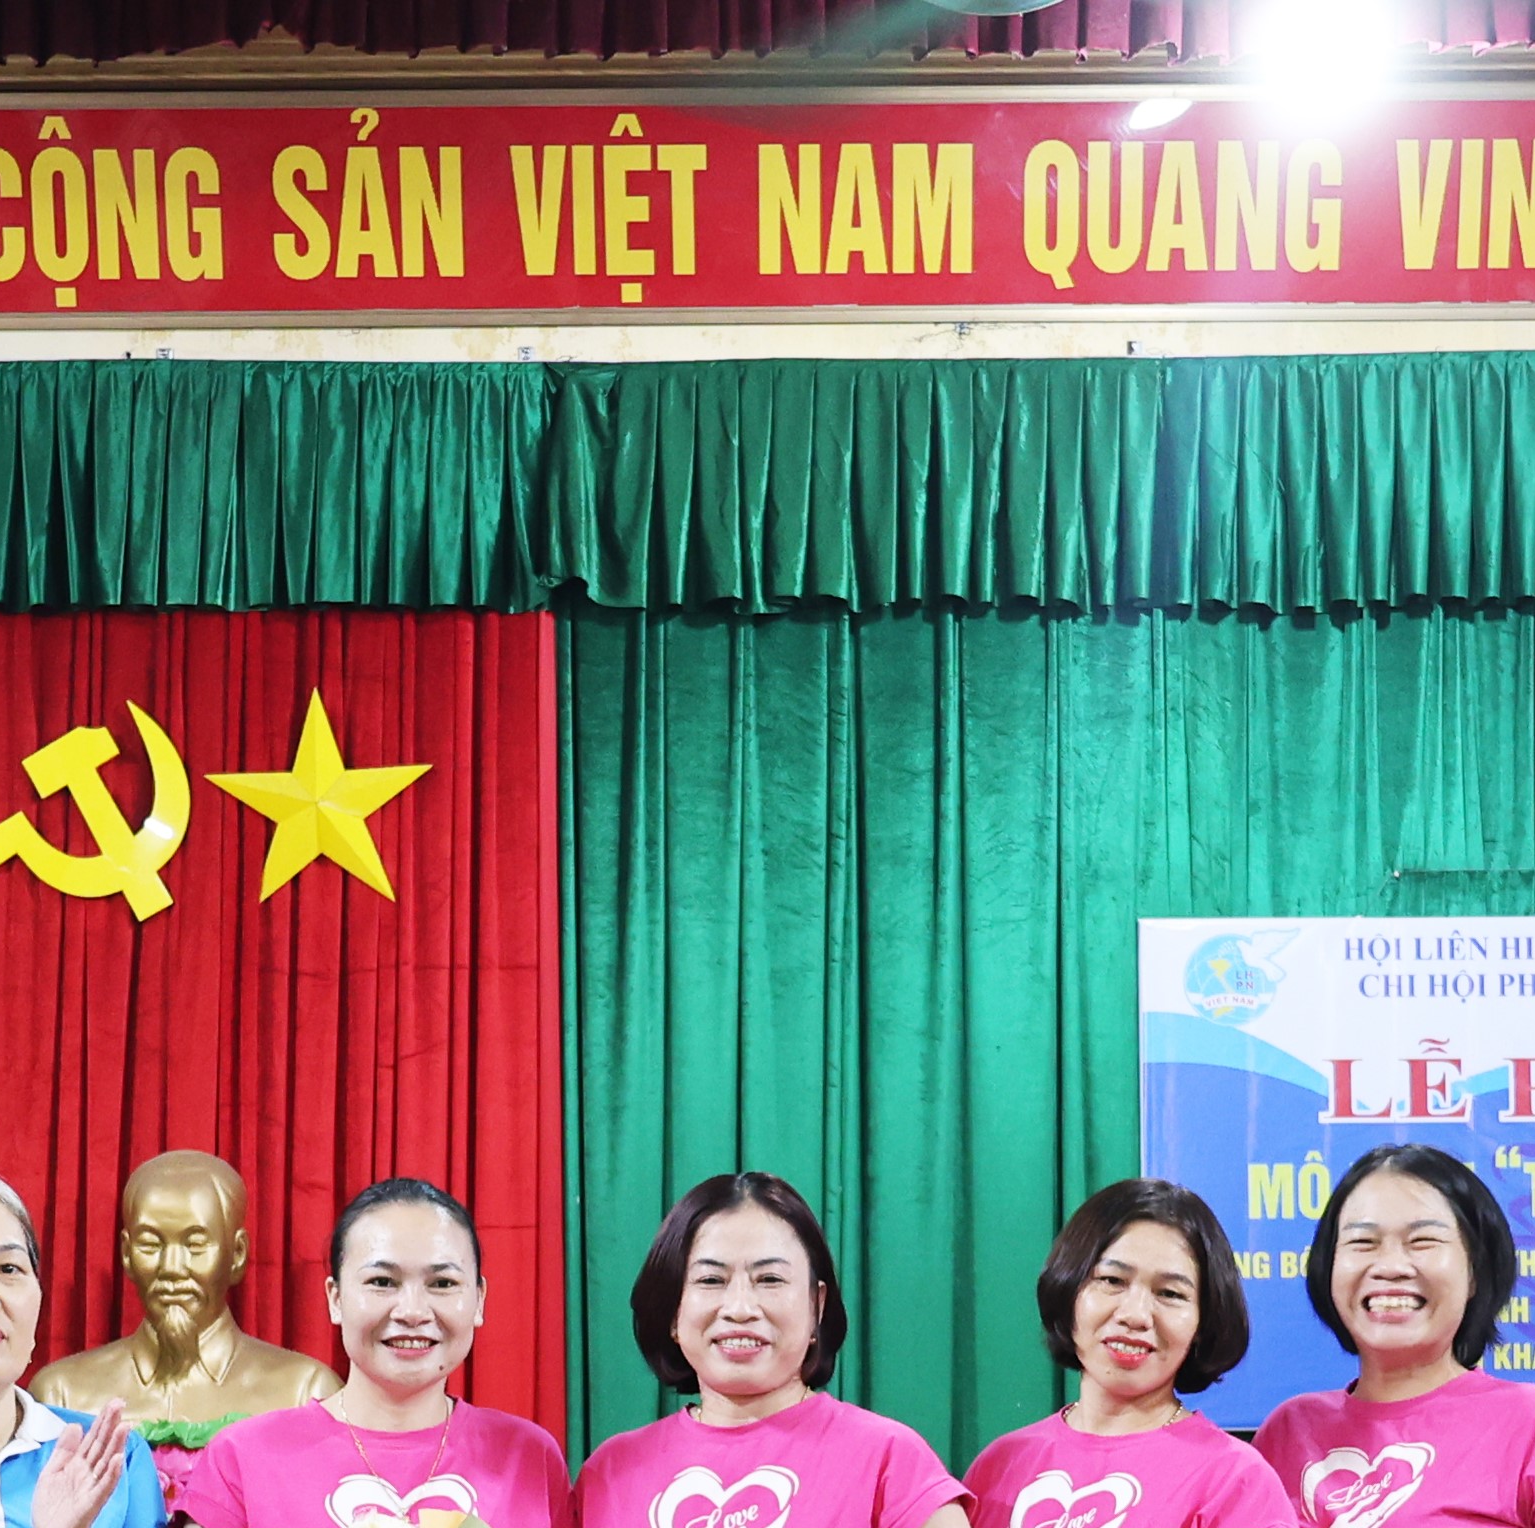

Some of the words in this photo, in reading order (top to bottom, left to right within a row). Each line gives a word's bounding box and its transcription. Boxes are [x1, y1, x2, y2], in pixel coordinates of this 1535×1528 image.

[272, 107, 467, 280] SẢN
[509, 114, 708, 303] VIỆT
[756, 140, 975, 276] NAM
[1021, 137, 1344, 292] QUANG
[1343, 932, 1402, 968] HỘI
[1413, 929, 1490, 961] LIÊN
[1358, 972, 1418, 998] CHI
[1427, 968, 1487, 1004] HỘI
[1319, 1037, 1472, 1123] LỄ
[1247, 1150, 1331, 1220] MÔ
[1232, 1251, 1271, 1279] NG
[1325, 1471, 1393, 1511] Love
